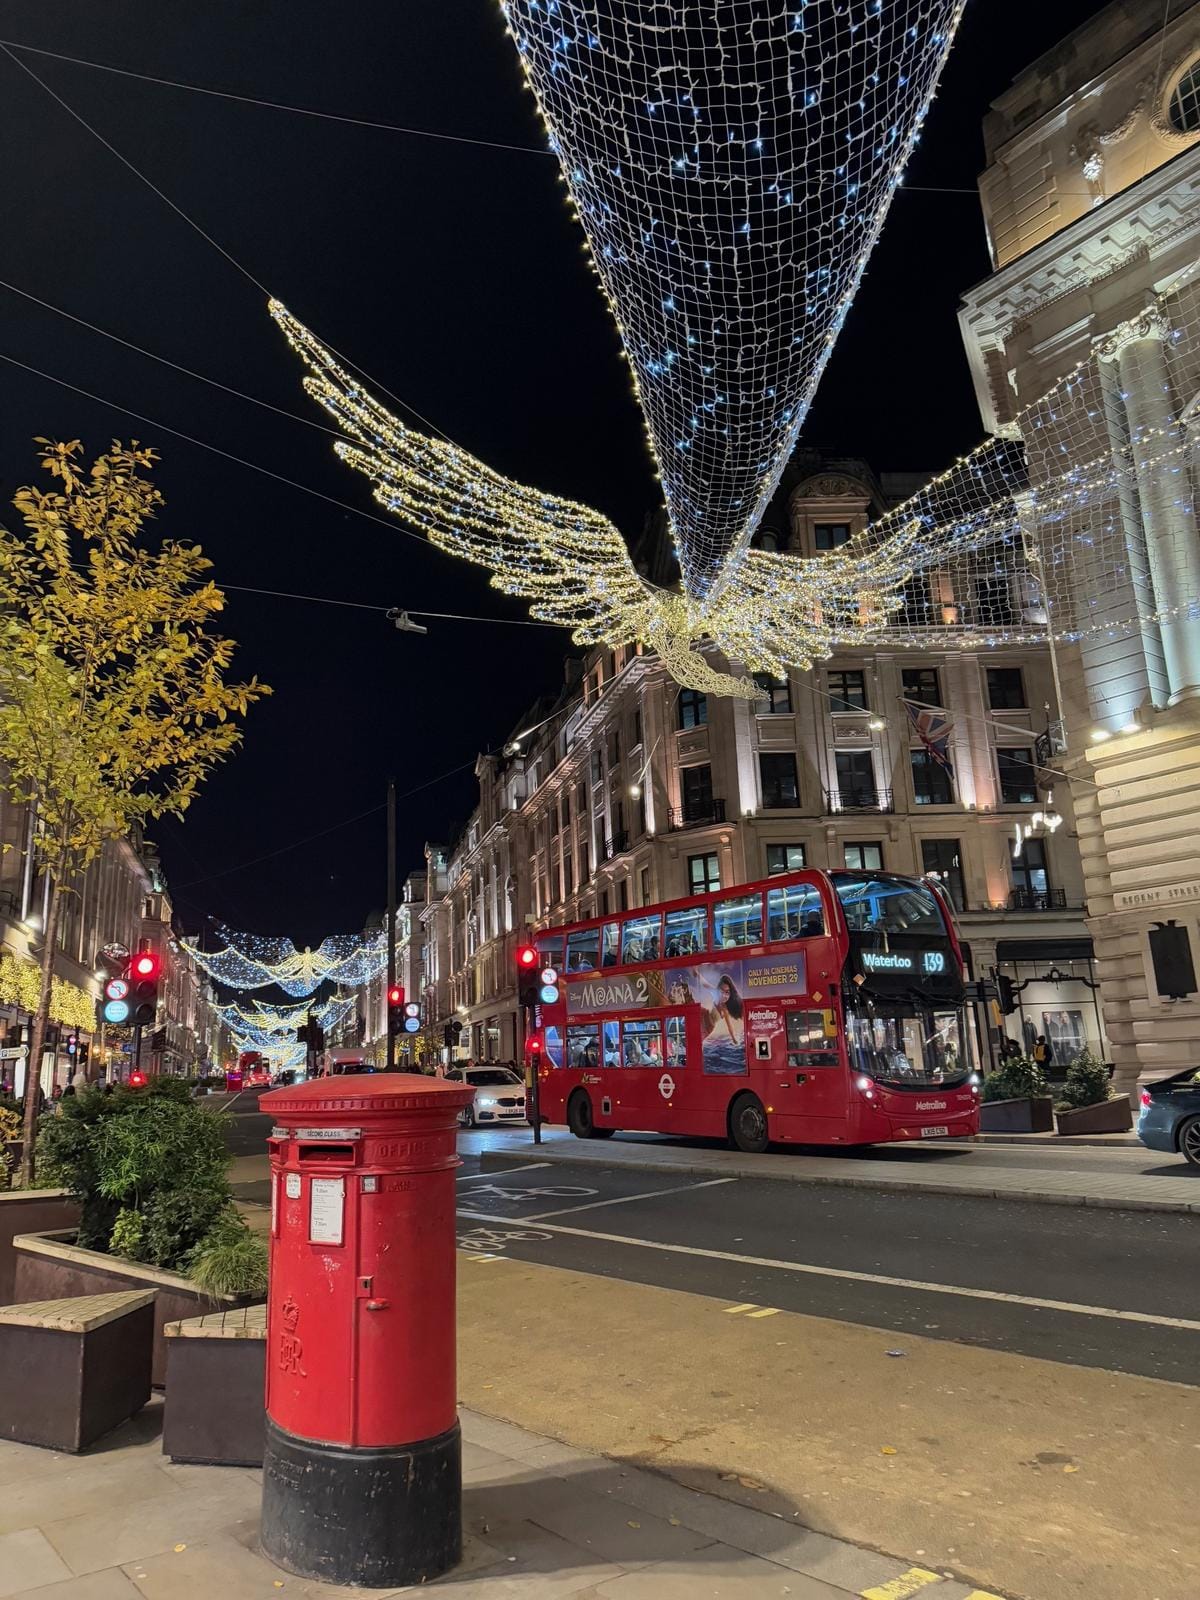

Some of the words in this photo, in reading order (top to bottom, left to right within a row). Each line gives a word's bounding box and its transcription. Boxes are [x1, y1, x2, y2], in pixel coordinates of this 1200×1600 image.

[1122, 892, 1160, 904] REGENT
[1168, 885, 1200, 897] STREE
[863, 953, 912, 968] Waterloo
[924, 953, 944, 972] 139
[748, 968, 763, 977] ONLY
[764, 967, 770, 975] IN
[771, 965, 798, 975] CINEMAS
[748, 975, 787, 986] NOVEMBER
[789, 973, 798, 983] 29
[581, 984, 634, 1008] MOANA
[636, 977, 649, 1002] 2
[748, 1010, 778, 1020] Metroline
[916, 1100, 947, 1110] Metroline
